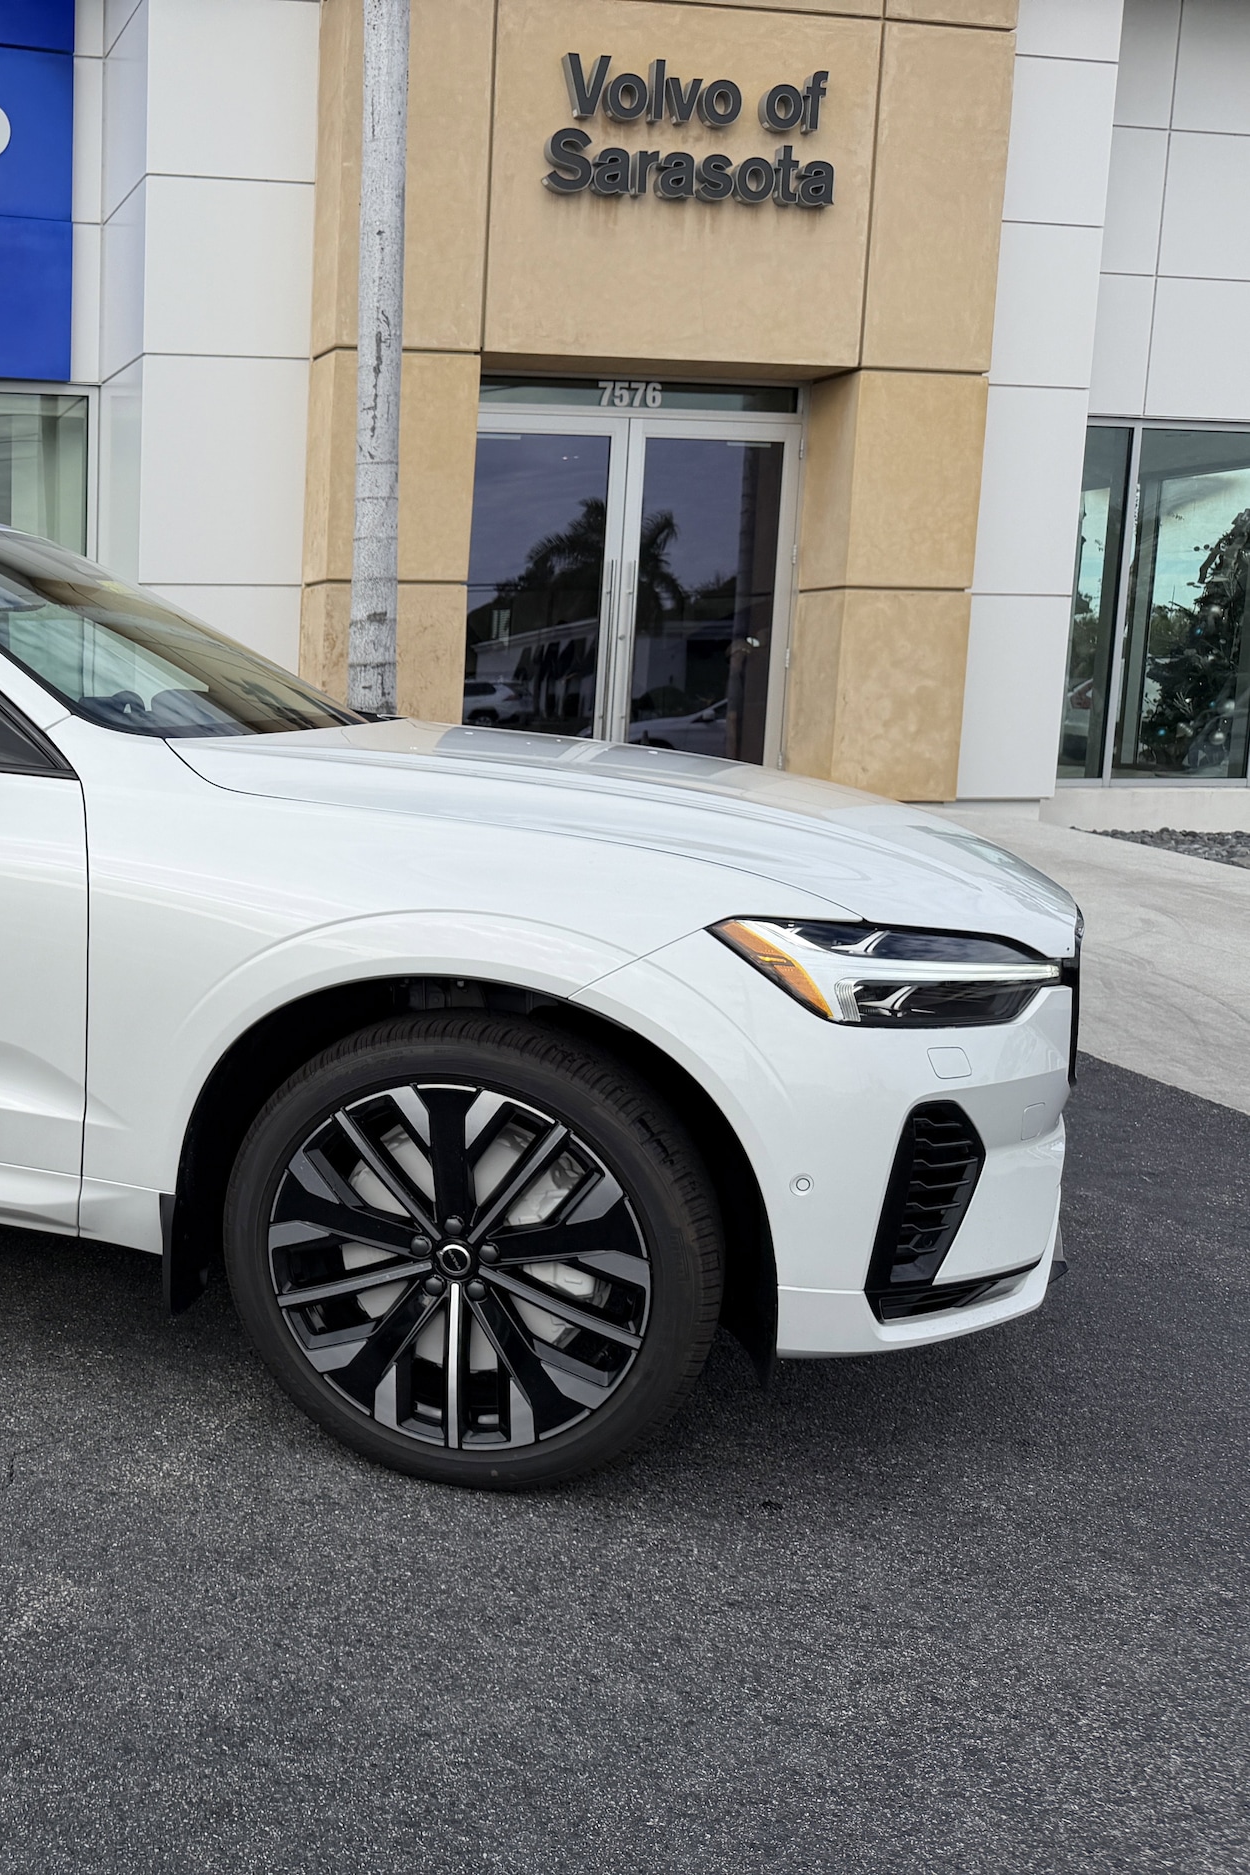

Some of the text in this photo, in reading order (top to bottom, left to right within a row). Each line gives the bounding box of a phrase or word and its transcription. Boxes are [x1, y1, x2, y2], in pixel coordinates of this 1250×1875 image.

[561, 52, 830, 134] Volvo of
[541, 128, 835, 208] Sarasota
[598, 381, 662, 408] 7576
